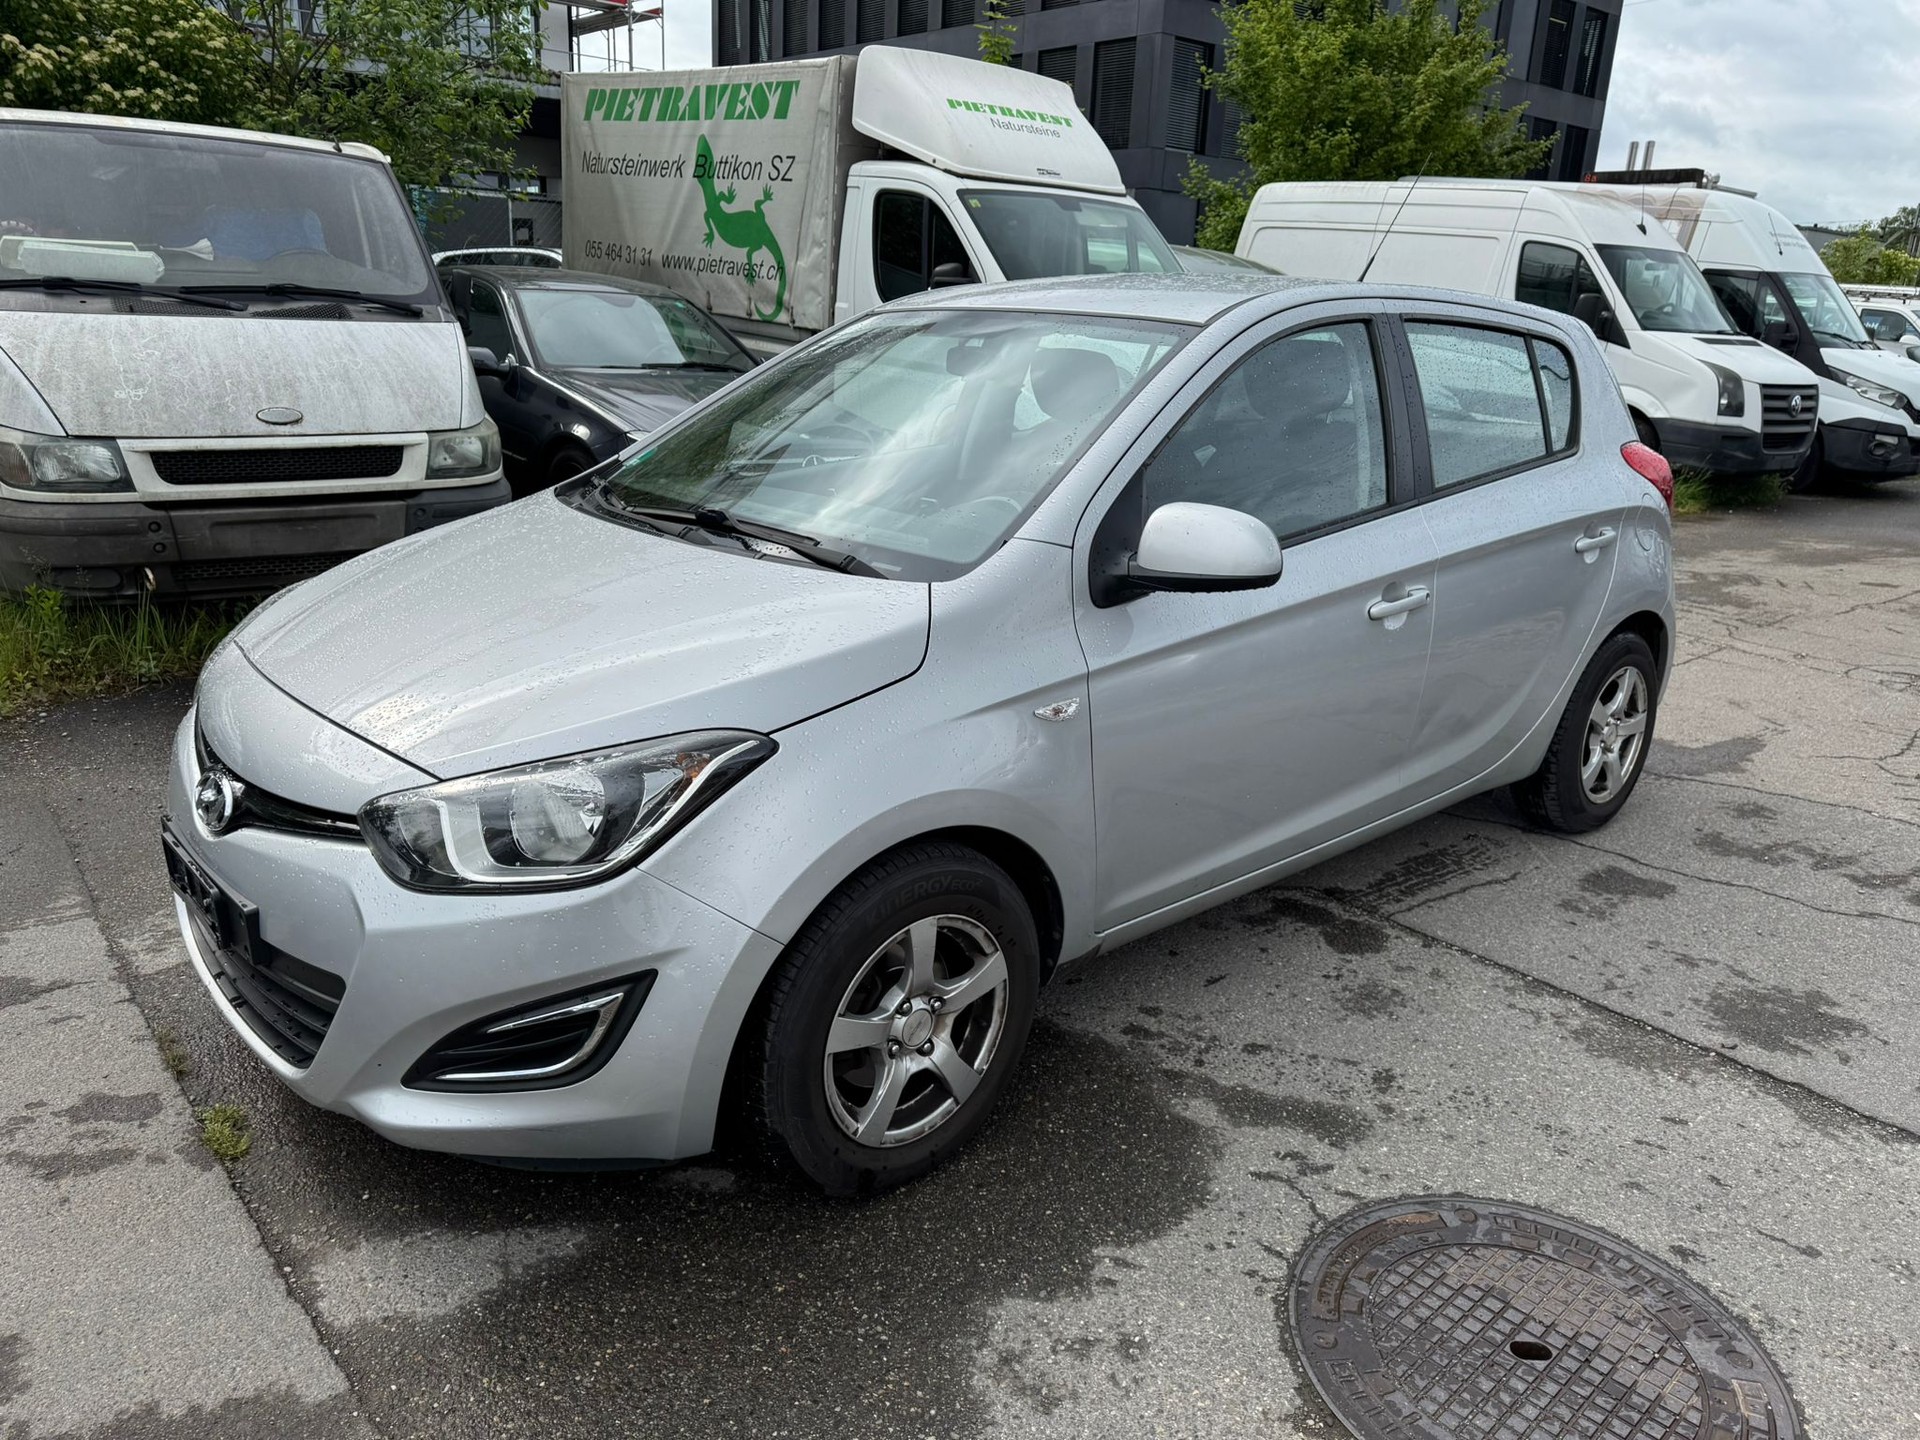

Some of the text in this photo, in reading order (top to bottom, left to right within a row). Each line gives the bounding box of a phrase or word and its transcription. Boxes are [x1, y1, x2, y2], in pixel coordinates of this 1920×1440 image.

[583, 80, 801, 122] PIETRAVEST
[946, 98, 1073, 128] PIETRAVEST
[990, 117, 1062, 139] Natursteine
[582, 150, 796, 182] Natursteinwerk Buttikon SZ
[585, 239, 785, 282] 055 464 31 31 www.pietravest.ch
